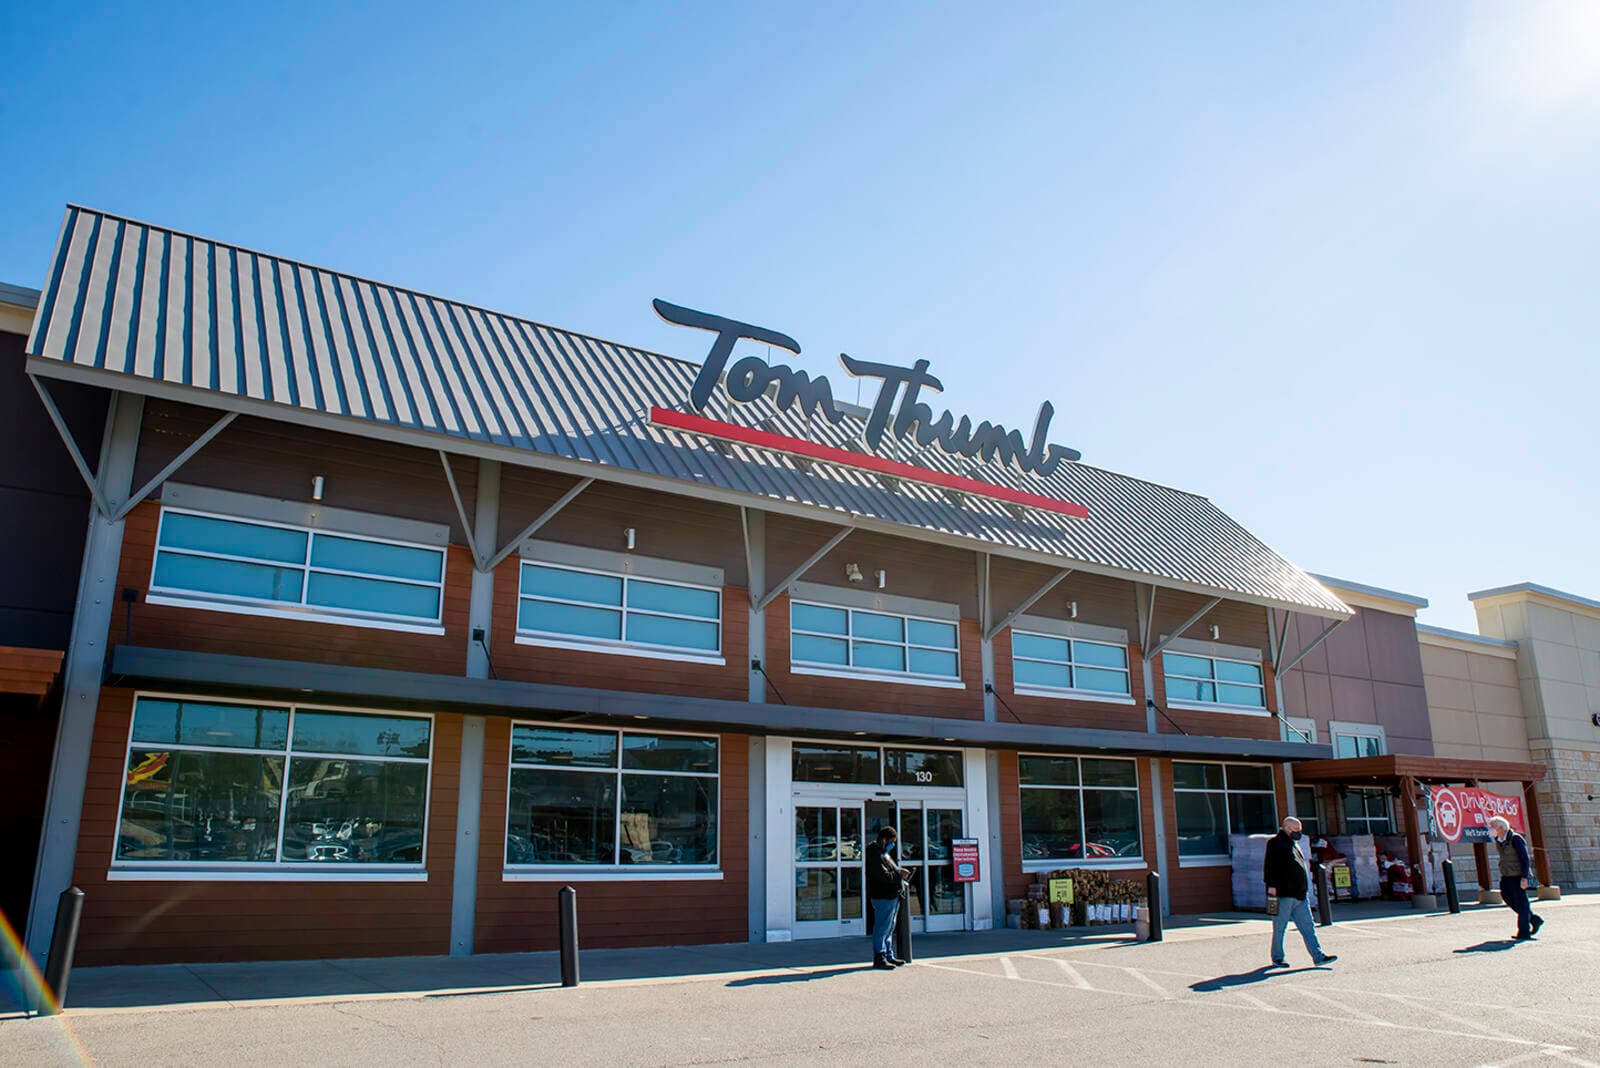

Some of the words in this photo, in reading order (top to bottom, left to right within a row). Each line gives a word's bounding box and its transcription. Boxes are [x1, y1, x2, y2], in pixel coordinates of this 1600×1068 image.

[652, 298, 844, 426] Tom
[840, 352, 1082, 480] Thumb
[915, 771, 933, 782] 130
